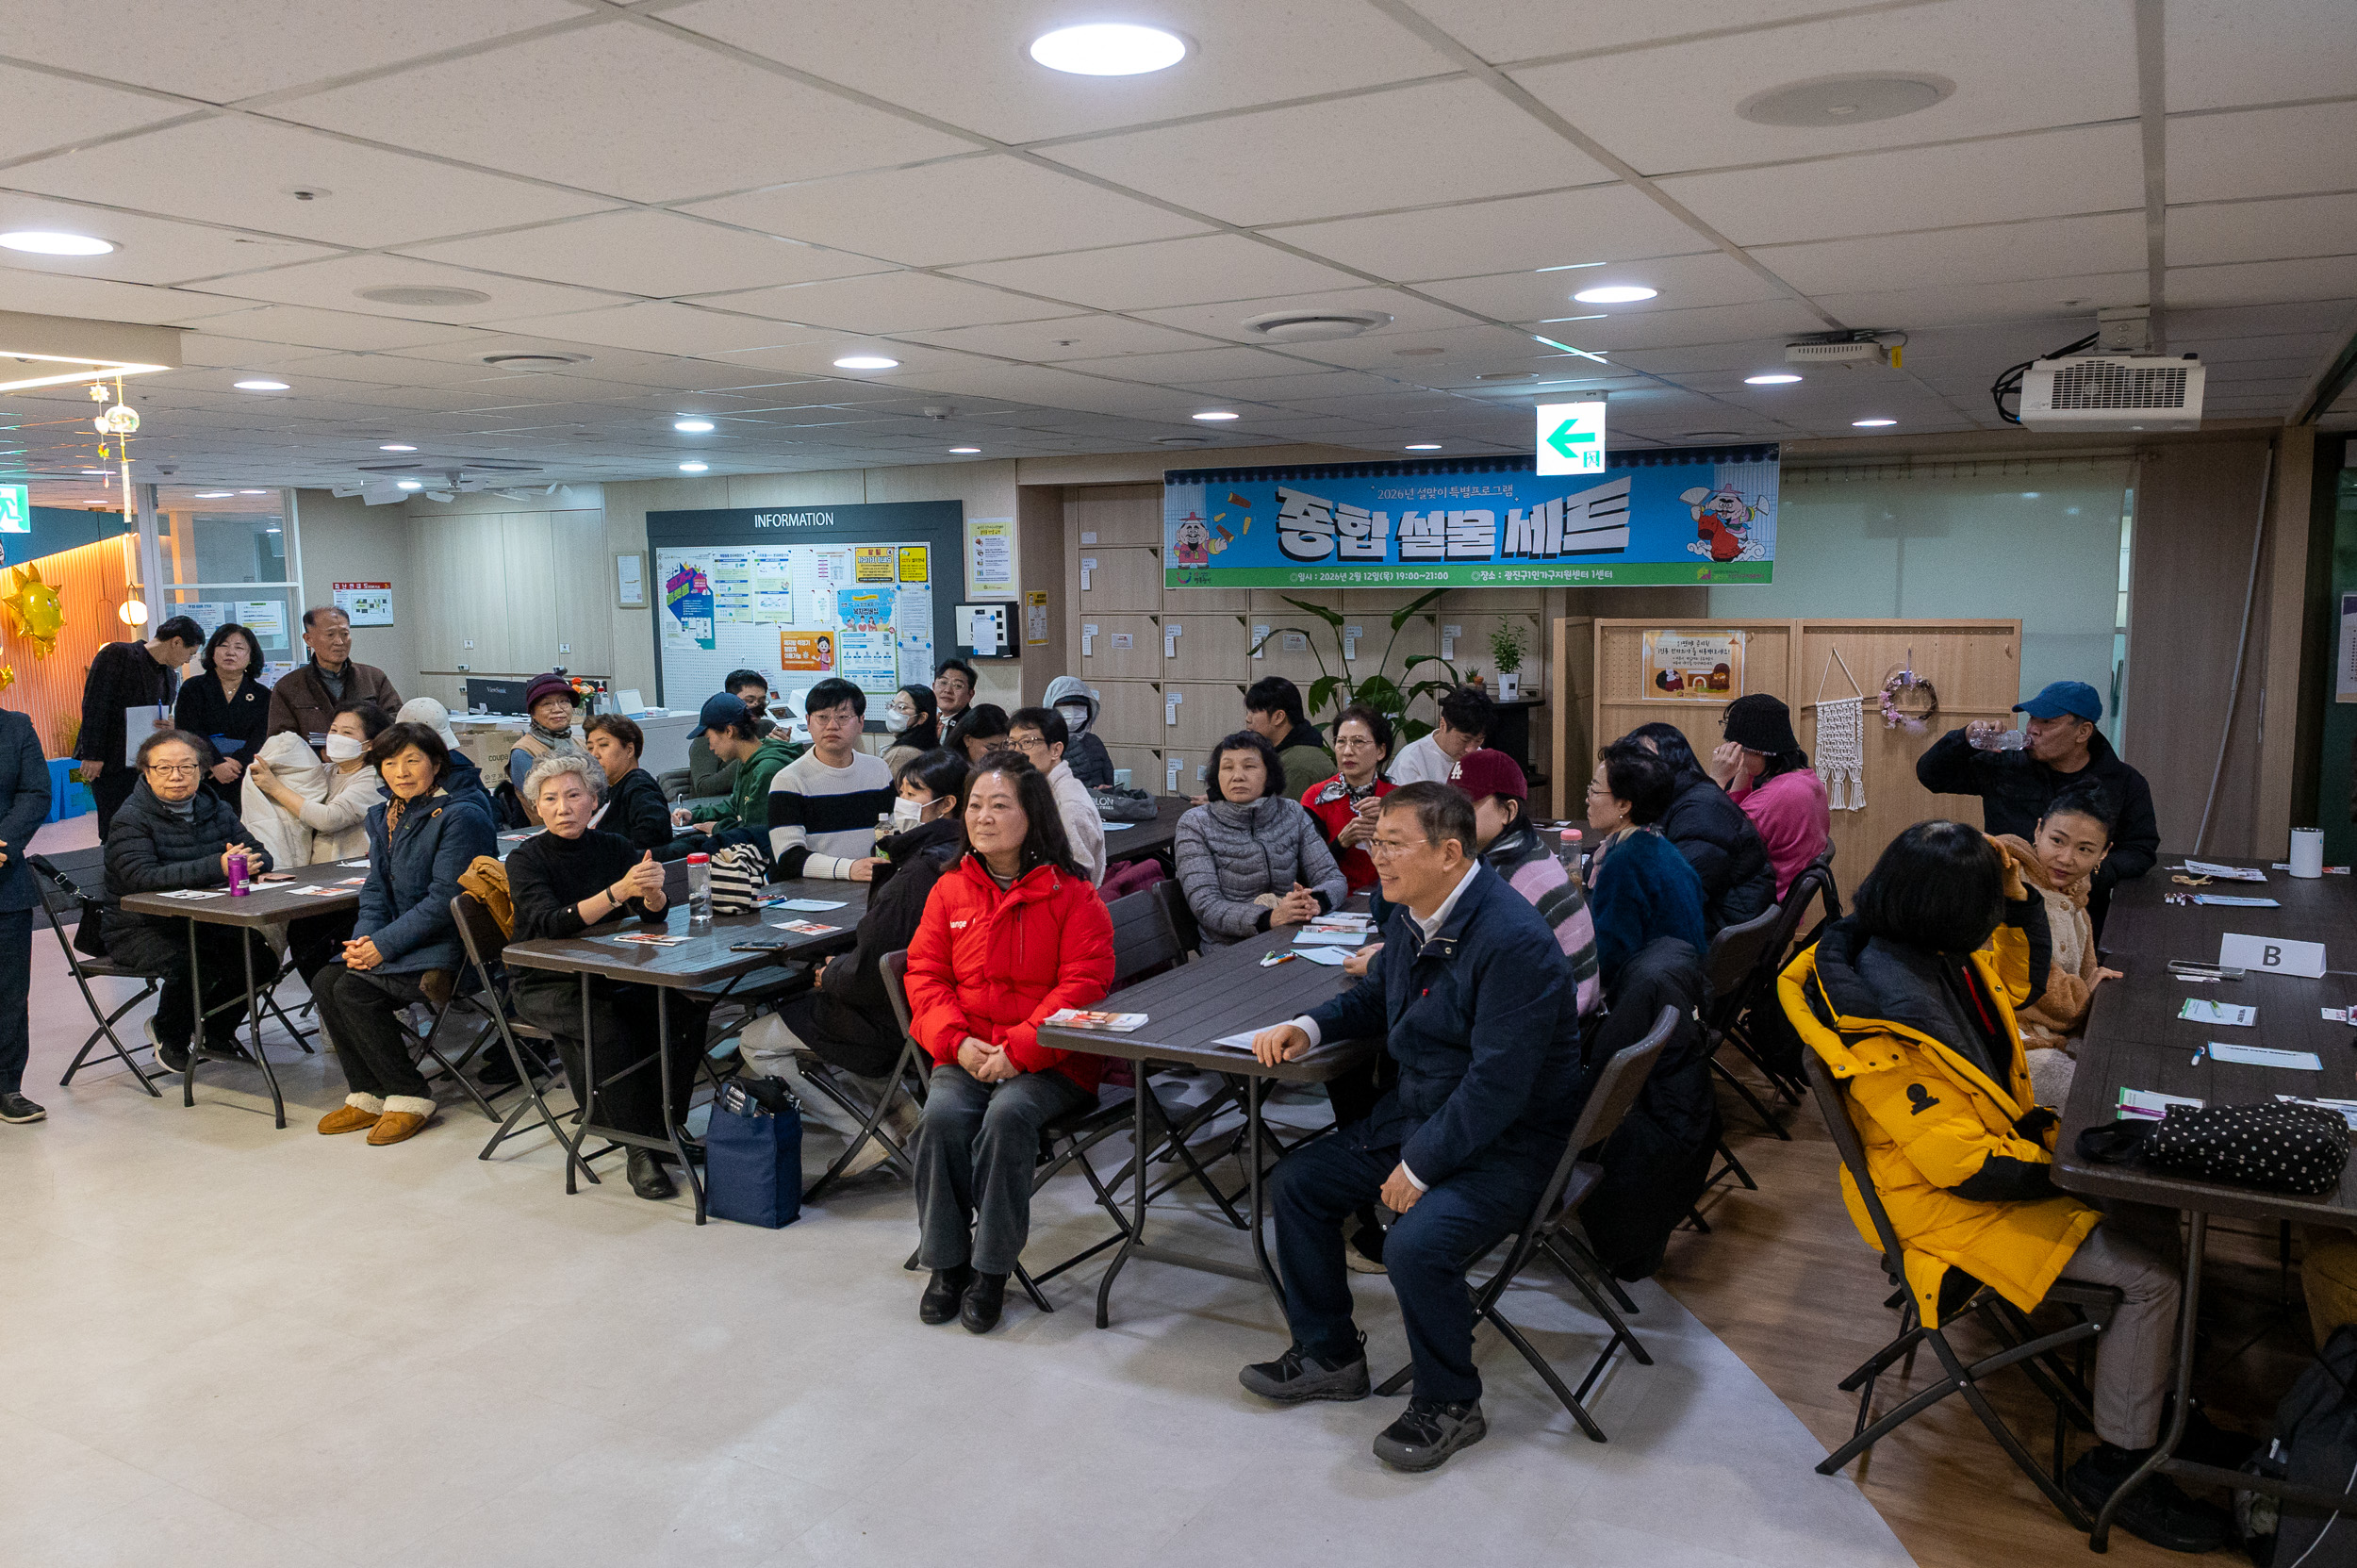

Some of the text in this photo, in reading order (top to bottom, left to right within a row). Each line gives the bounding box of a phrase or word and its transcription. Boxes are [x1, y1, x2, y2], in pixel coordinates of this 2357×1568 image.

[1377, 484, 1514, 500] 2026년 설맞이 특별프로그램
[754, 512, 834, 528] INFORMATION
[1277, 475, 1632, 561] 종합 설물 세트
[1297, 570, 1313, 582] 일시
[1320, 570, 1348, 582] 2026년
[1349, 571, 1361, 582] 2월
[1363, 570, 1393, 582] 12일(목)
[1395, 570, 1449, 581] 19:00~21:00
[1480, 569, 1496, 581] 장소
[1504, 569, 1590, 581] 광진구1인가구지원센터
[1591, 569, 1613, 579] 1센터
[1450, 761, 1463, 781] LA
[2262, 945, 2282, 966] B
